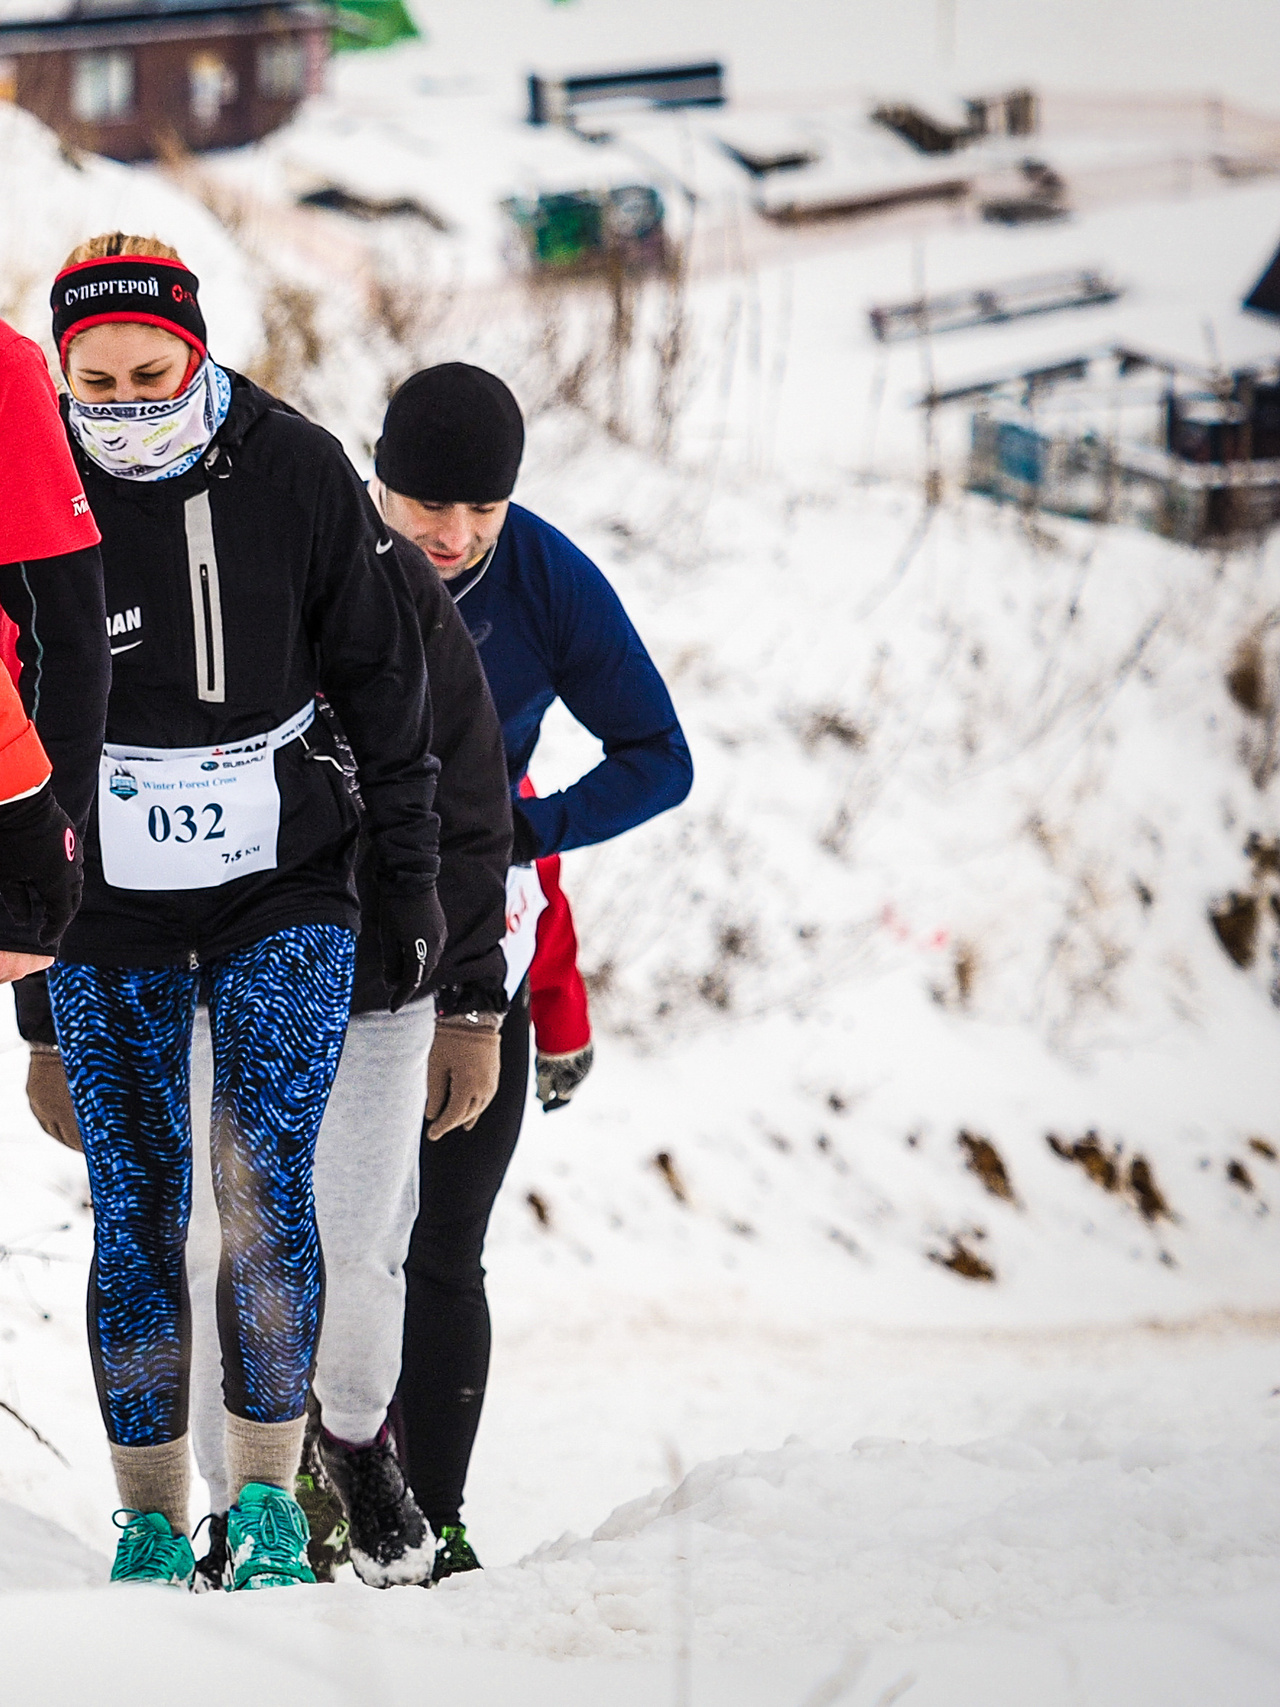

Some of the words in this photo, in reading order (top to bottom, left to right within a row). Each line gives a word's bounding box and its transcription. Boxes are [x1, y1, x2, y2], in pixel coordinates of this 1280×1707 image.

[65, 276, 159, 306] СУПЕРГЕРОЙ
[222, 755, 265, 769] SUBARU
[142, 781, 175, 790] Winter
[179, 778, 209, 790] Forest
[148, 803, 226, 843] 032
